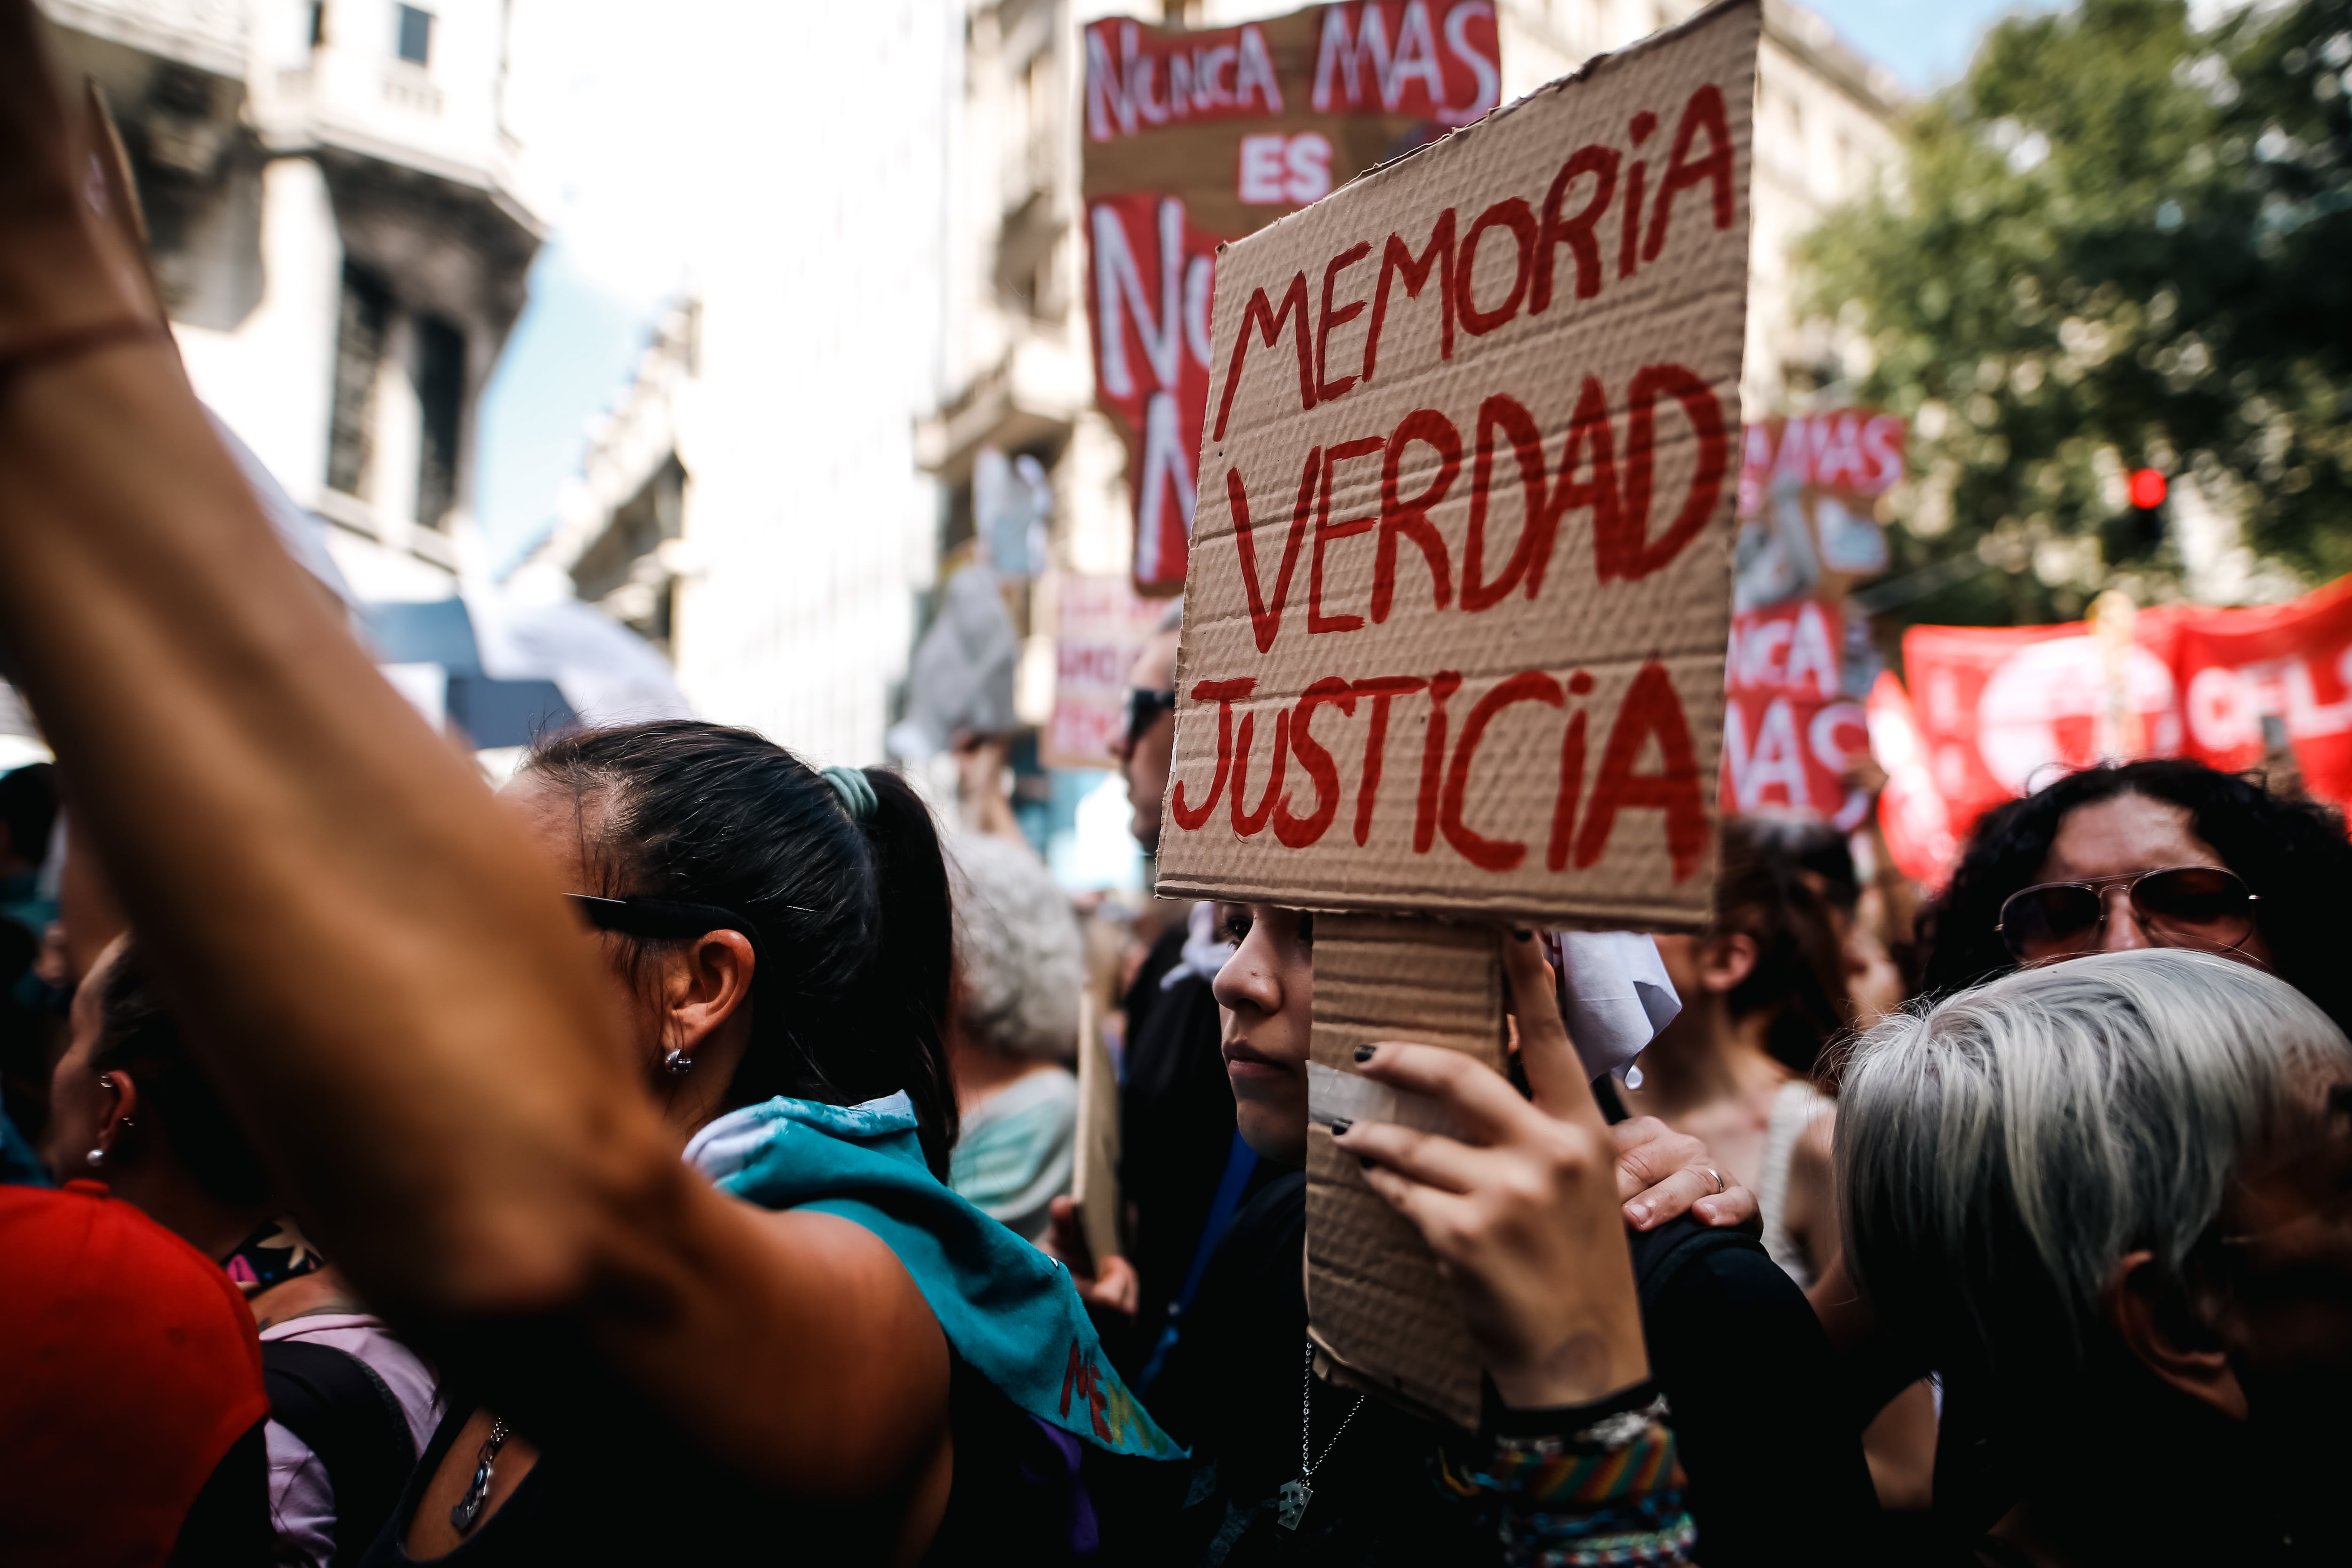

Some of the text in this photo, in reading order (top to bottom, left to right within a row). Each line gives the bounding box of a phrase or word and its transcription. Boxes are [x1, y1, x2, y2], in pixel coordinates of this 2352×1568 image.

[1088, 1, 1500, 142] NUNCA MAS
[1239, 133, 1333, 204] ES
[1227, 363, 1728, 653] VERDAD
